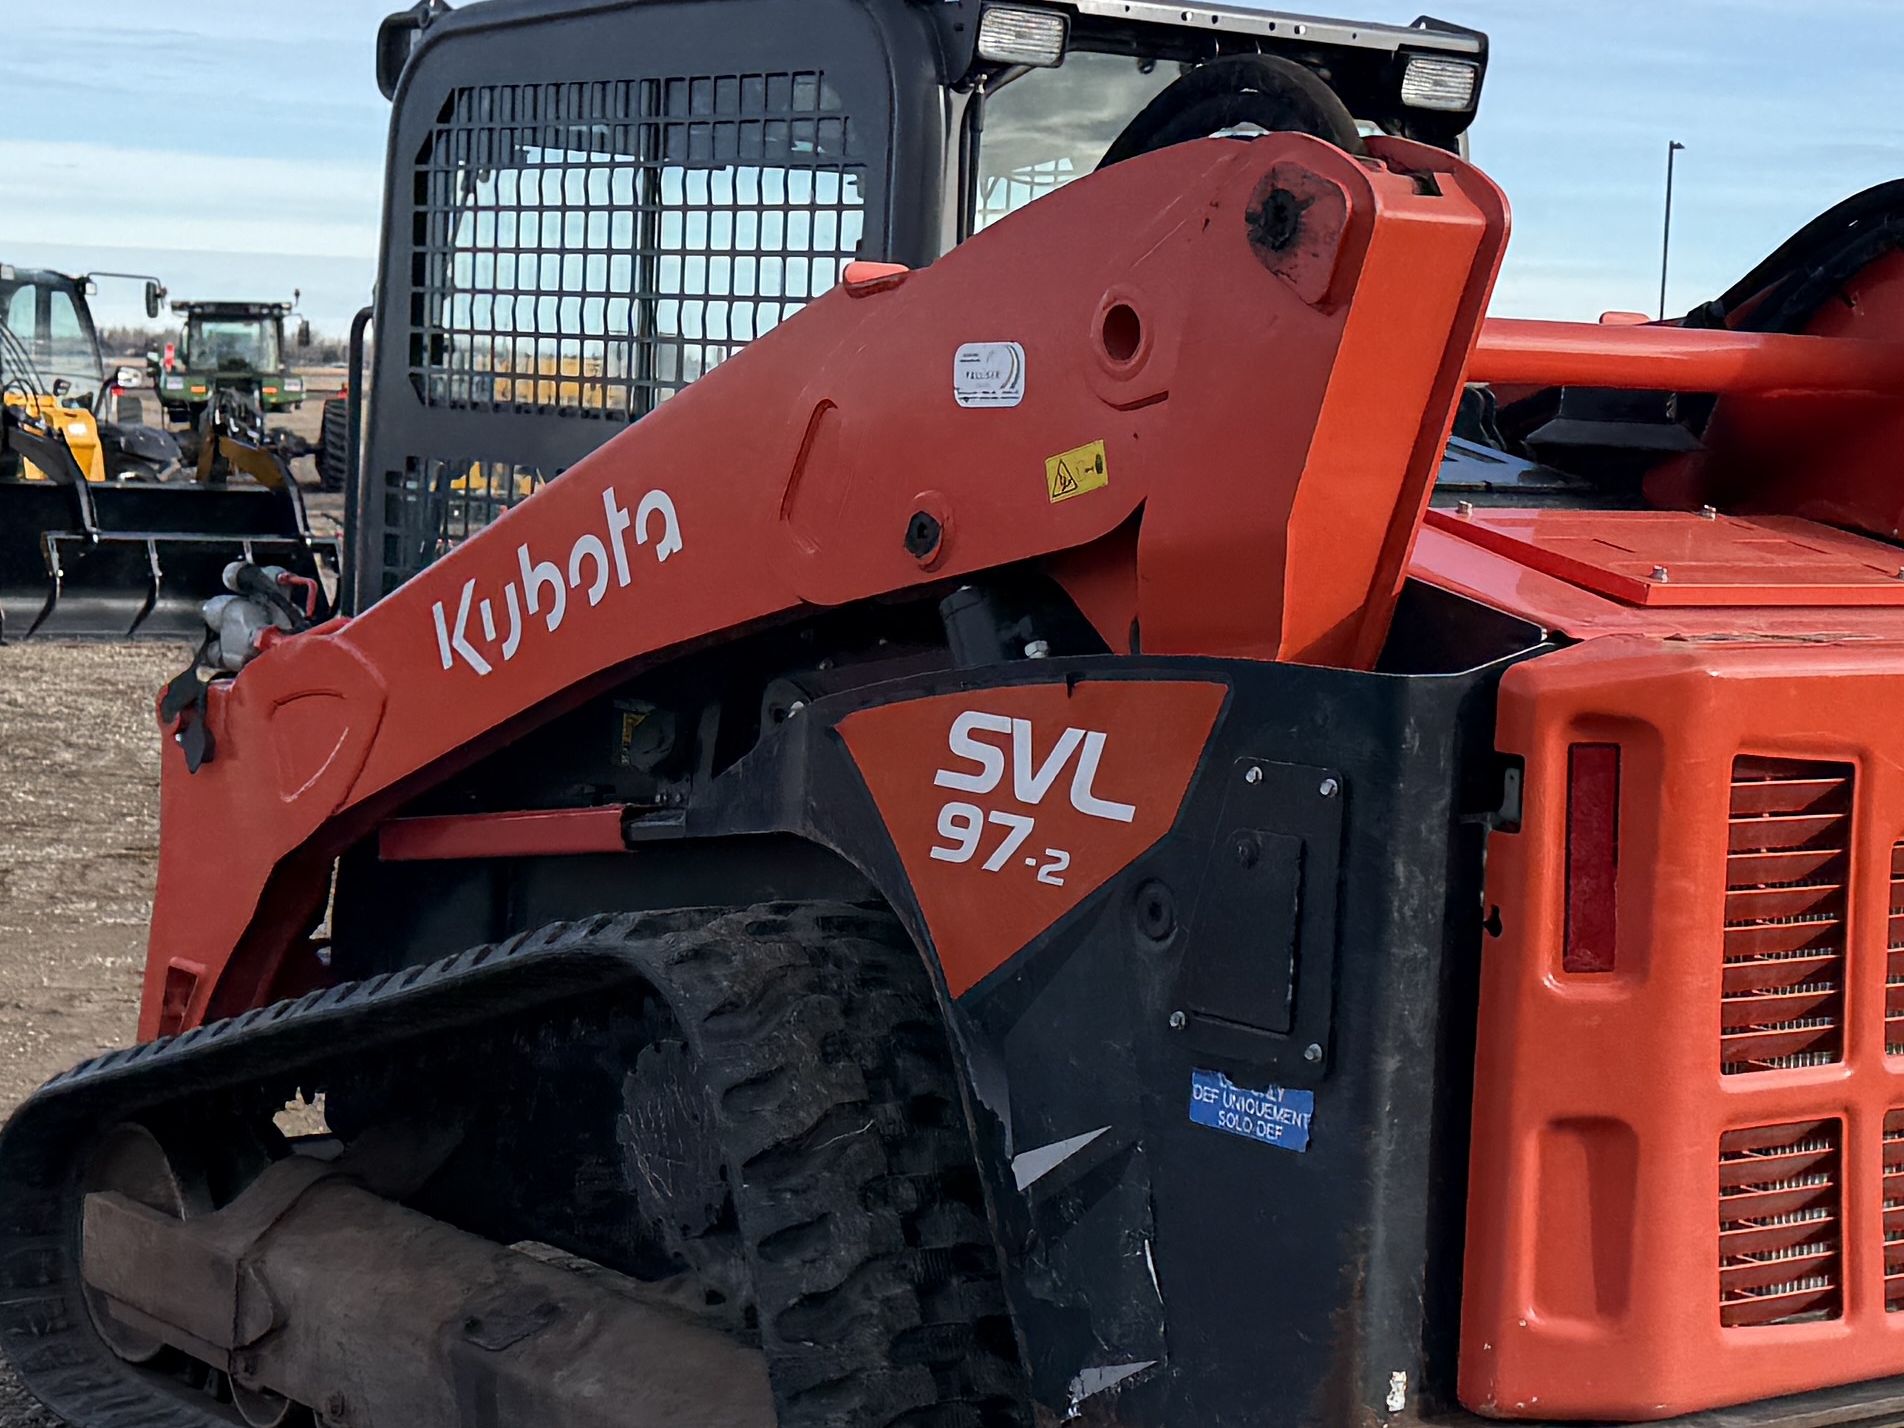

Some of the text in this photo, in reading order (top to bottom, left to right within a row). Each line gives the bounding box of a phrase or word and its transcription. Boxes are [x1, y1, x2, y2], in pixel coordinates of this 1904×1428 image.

[432, 486, 683, 676] Kubota
[933, 710, 1136, 823] SVL
[1192, 1083, 1311, 1130] DEF UNIQUEMENT
[1218, 1110, 1283, 1140] SOLO DEF
